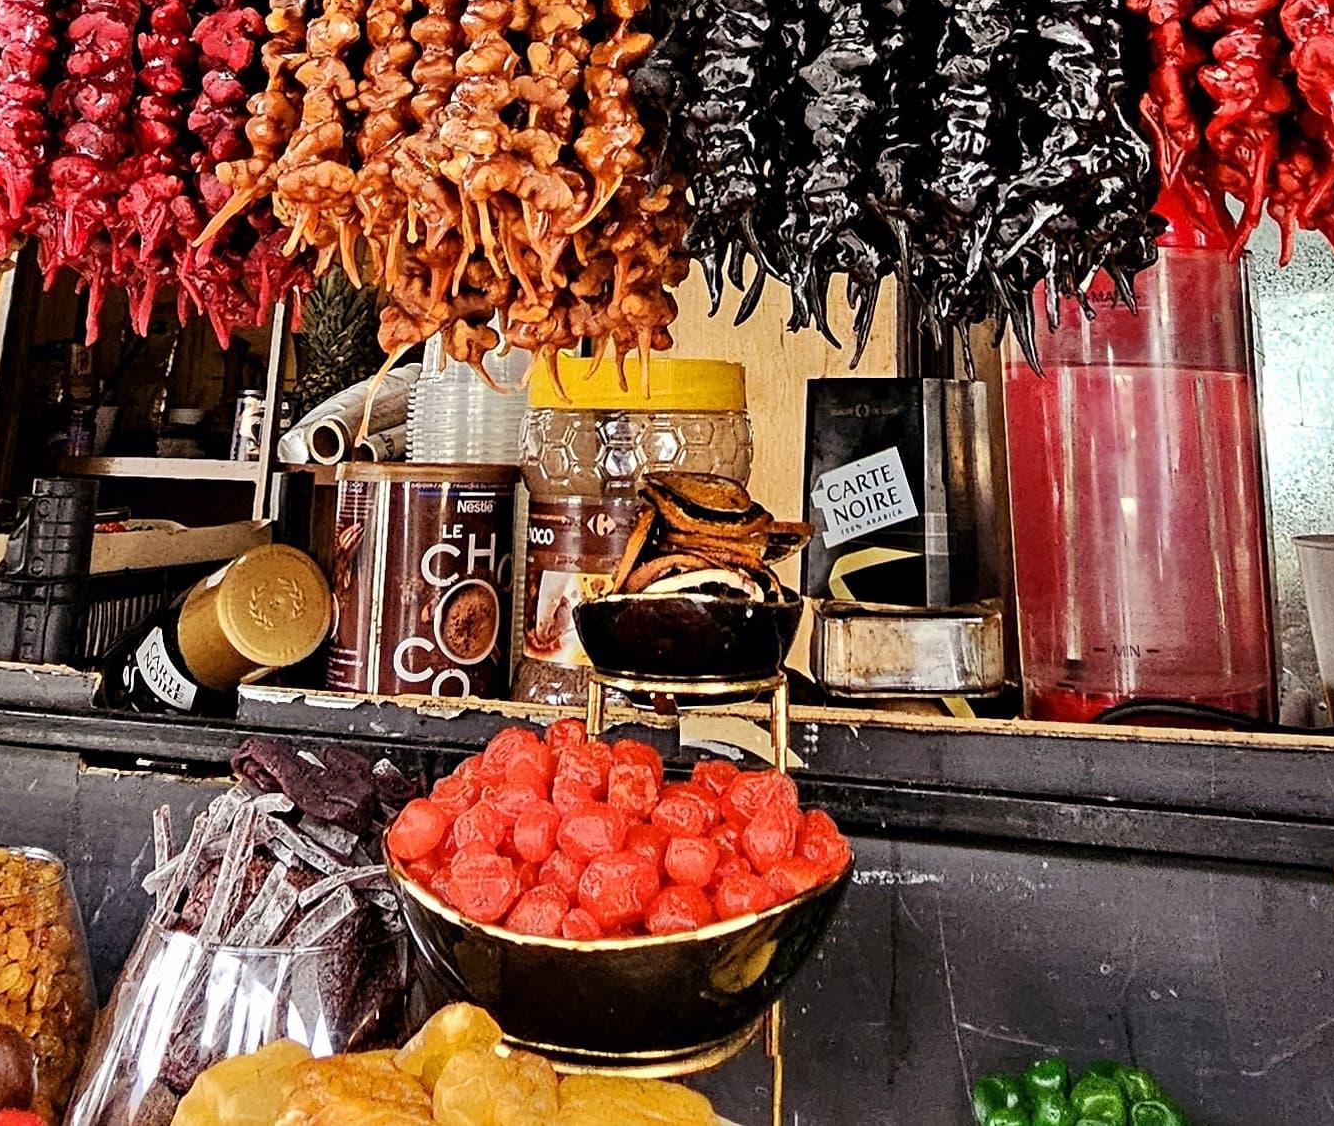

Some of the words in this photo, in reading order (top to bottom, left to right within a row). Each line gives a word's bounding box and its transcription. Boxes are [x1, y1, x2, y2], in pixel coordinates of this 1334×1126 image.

[827, 464, 895, 503] CARTE
[833, 486, 902, 525] NOIRE
[866, 508, 903, 525] ARABICA
[442, 524, 464, 539] LE
[527, 527, 555, 545] OCO
[1112, 644, 1141, 658] MIN
[143, 652, 185, 704] NOIRE
[150, 641, 187, 692] CARTE
